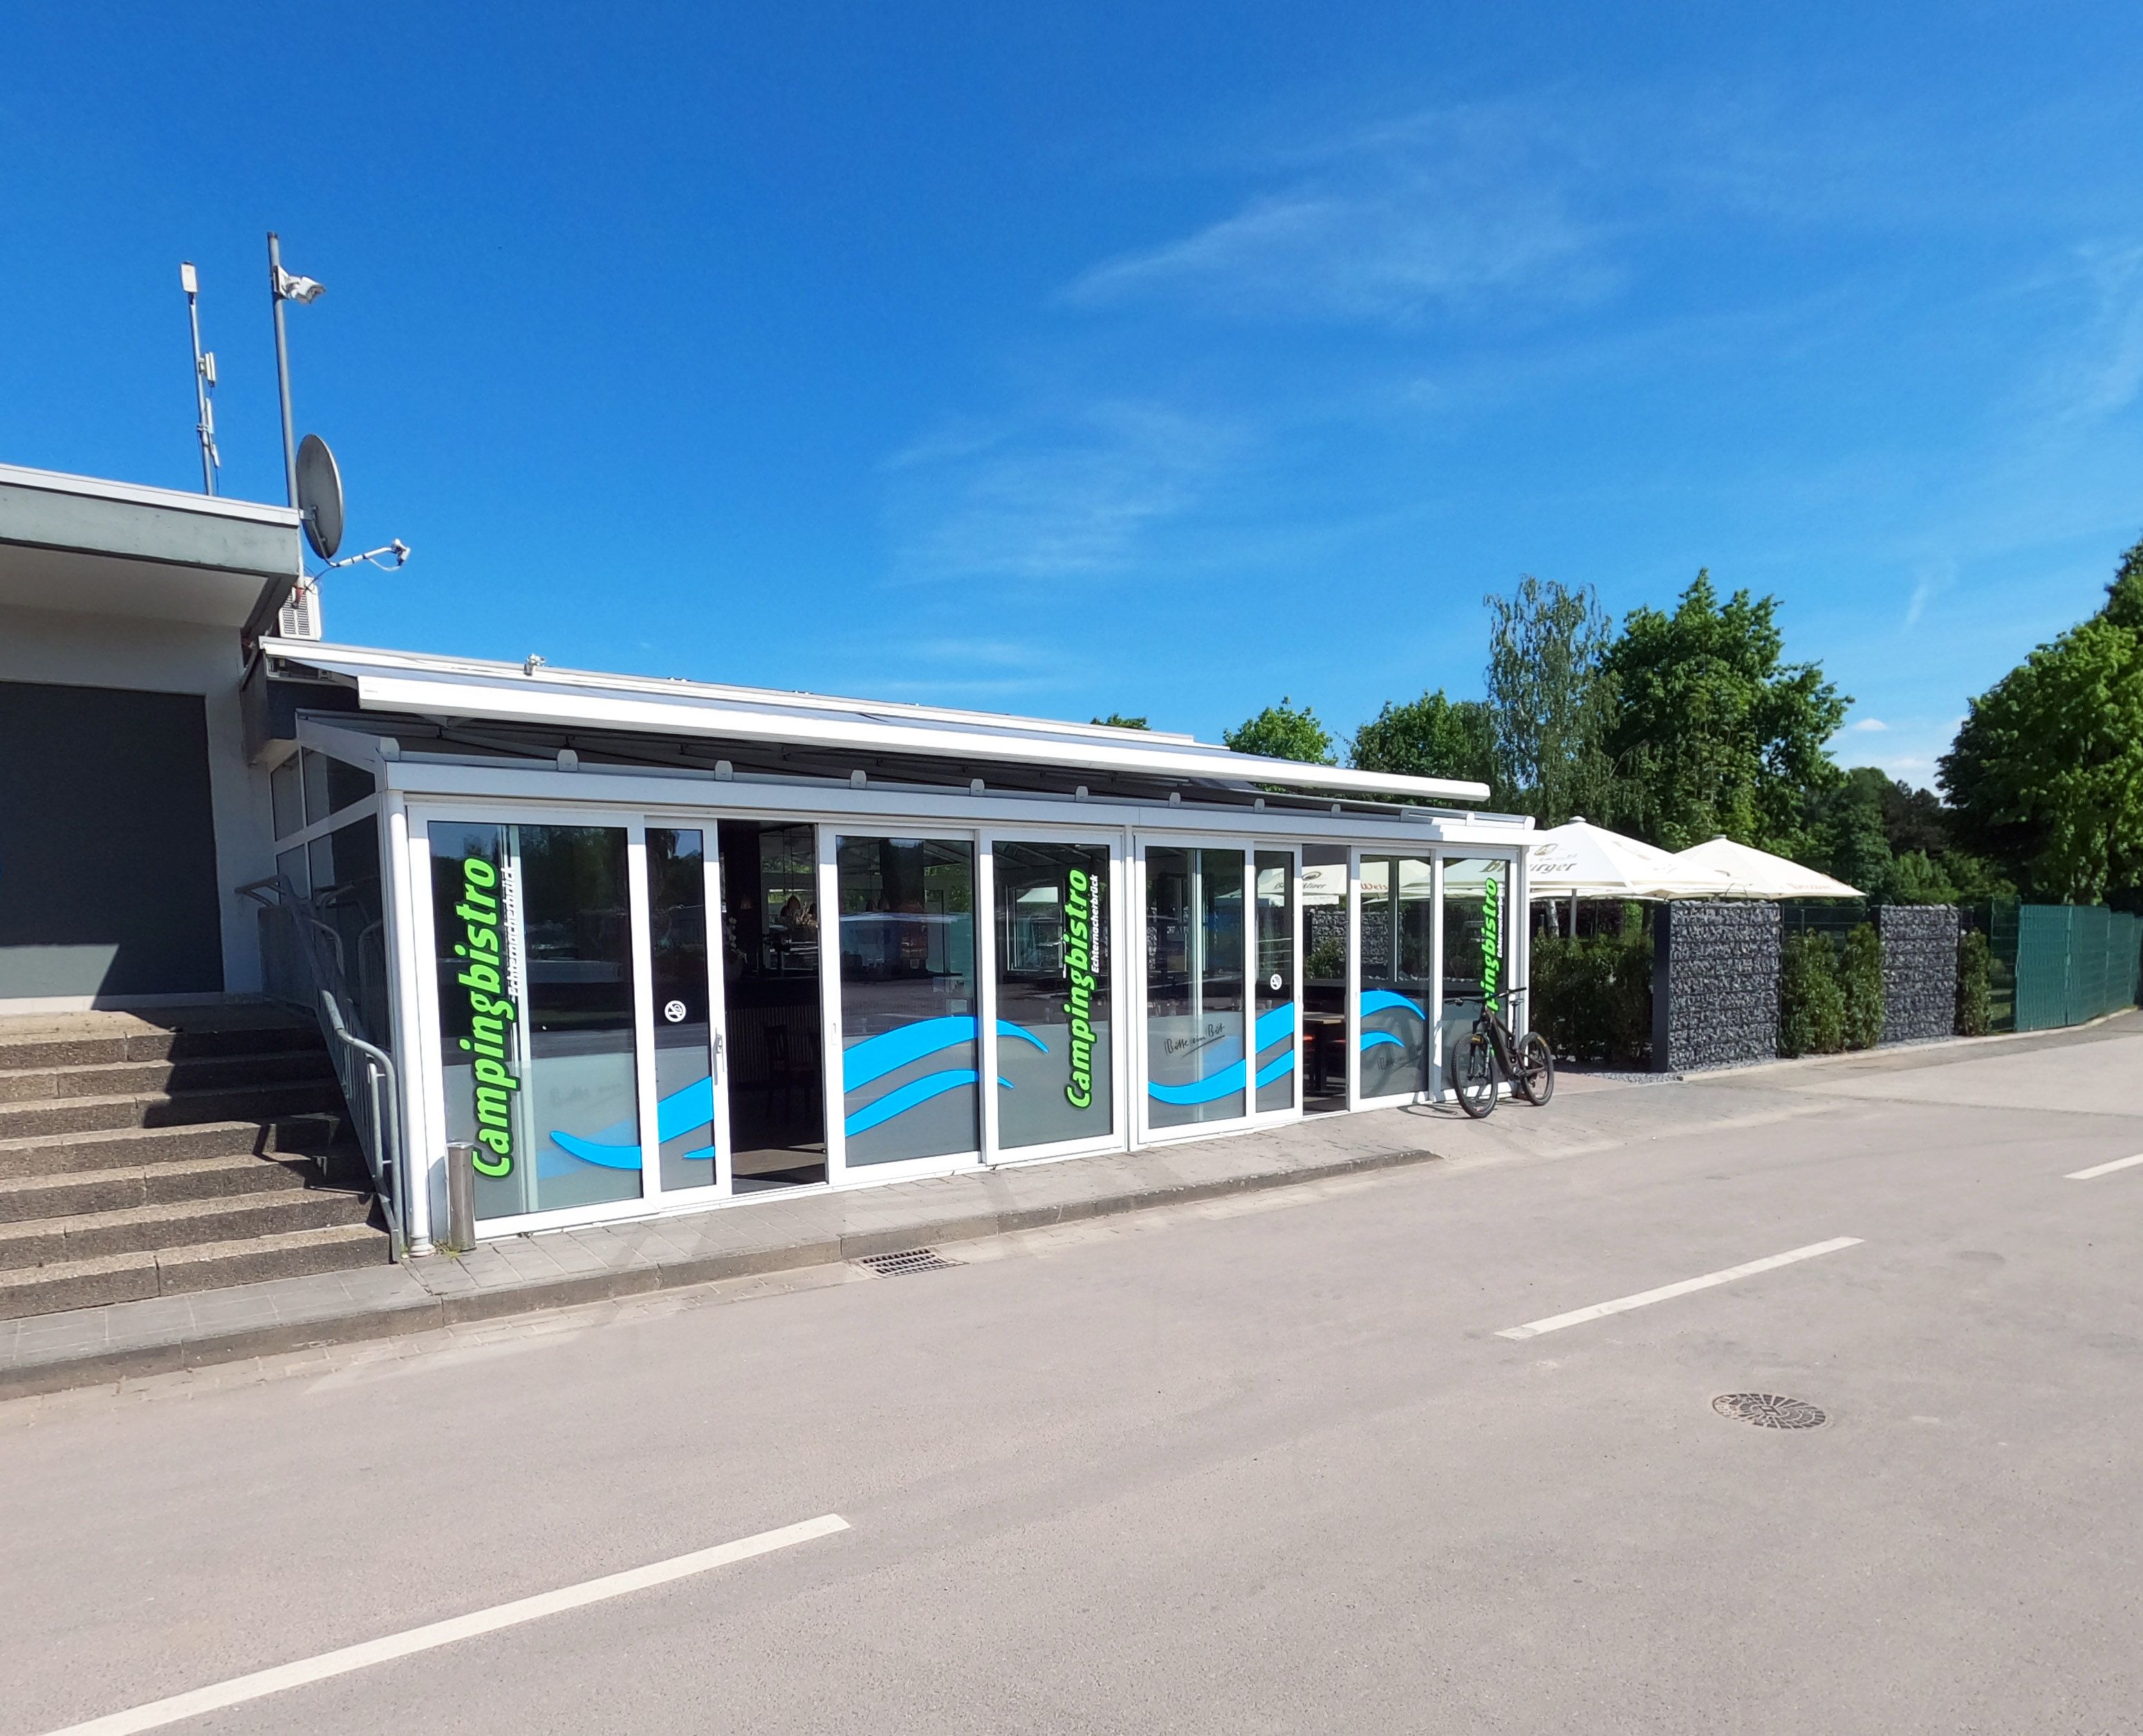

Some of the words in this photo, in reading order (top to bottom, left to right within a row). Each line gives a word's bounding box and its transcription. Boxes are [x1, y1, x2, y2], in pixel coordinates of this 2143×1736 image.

[454, 856, 519, 1176] Campingbistro
[1064, 869, 1096, 1108] Campingbistro
[1480, 877, 1499, 1013] pingbistro
[1165, 1038, 1189, 1056] Bitte
[1207, 1023, 1225, 1037] Bit
